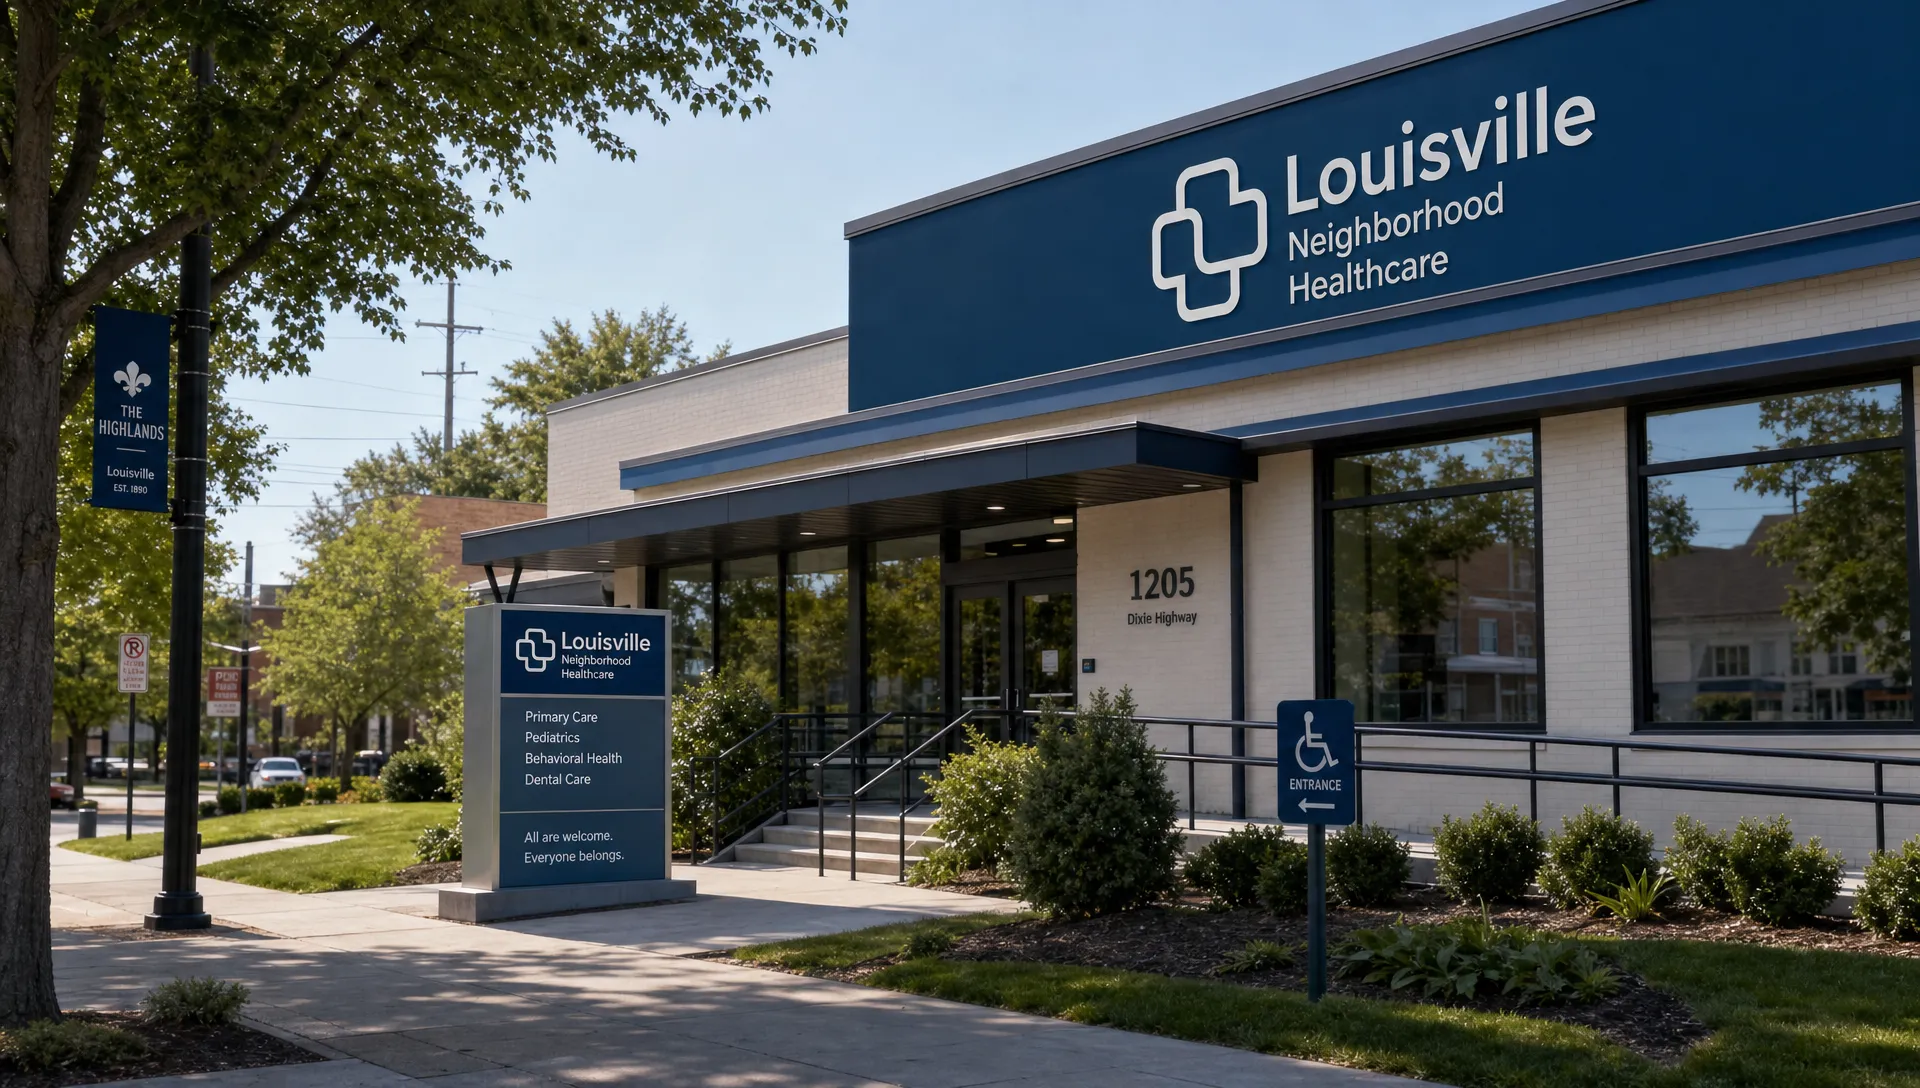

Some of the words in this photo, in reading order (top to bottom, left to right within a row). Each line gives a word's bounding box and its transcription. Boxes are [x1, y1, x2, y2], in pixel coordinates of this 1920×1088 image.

[1286, 85, 1596, 216] Louisville
[1288, 181, 1504, 261] Neighborhood
[1289, 250, 1449, 305] Healthcare
[120, 404, 143, 419] THE
[99, 419, 165, 441] HIGHLANDS
[106, 465, 155, 480] Louisville
[113, 483, 129, 493] EST.
[130, 485, 148, 494] 1890
[1129, 565, 1195, 601] 1205
[1127, 612, 1152, 626] Dixie
[1155, 610, 1198, 627] Highway
[561, 631, 651, 652] Louisville
[561, 654, 631, 668] Neighborhood
[561, 669, 615, 680] Healthcare
[525, 710, 570, 726] Primary
[572, 711, 598, 723] Care
[525, 731, 580, 743] Pediatrics
[525, 752, 584, 764] Behavioral
[587, 752, 623, 764] Health
[525, 773, 562, 785] Dental
[565, 773, 591, 785] Care
[1289, 778, 1342, 791] ENTRANCE
[524, 831, 539, 843] All
[542, 833, 560, 843] are
[562, 830, 613, 842] welcome.
[524, 852, 576, 866] Everyone
[579, 850, 625, 863] belongs.
